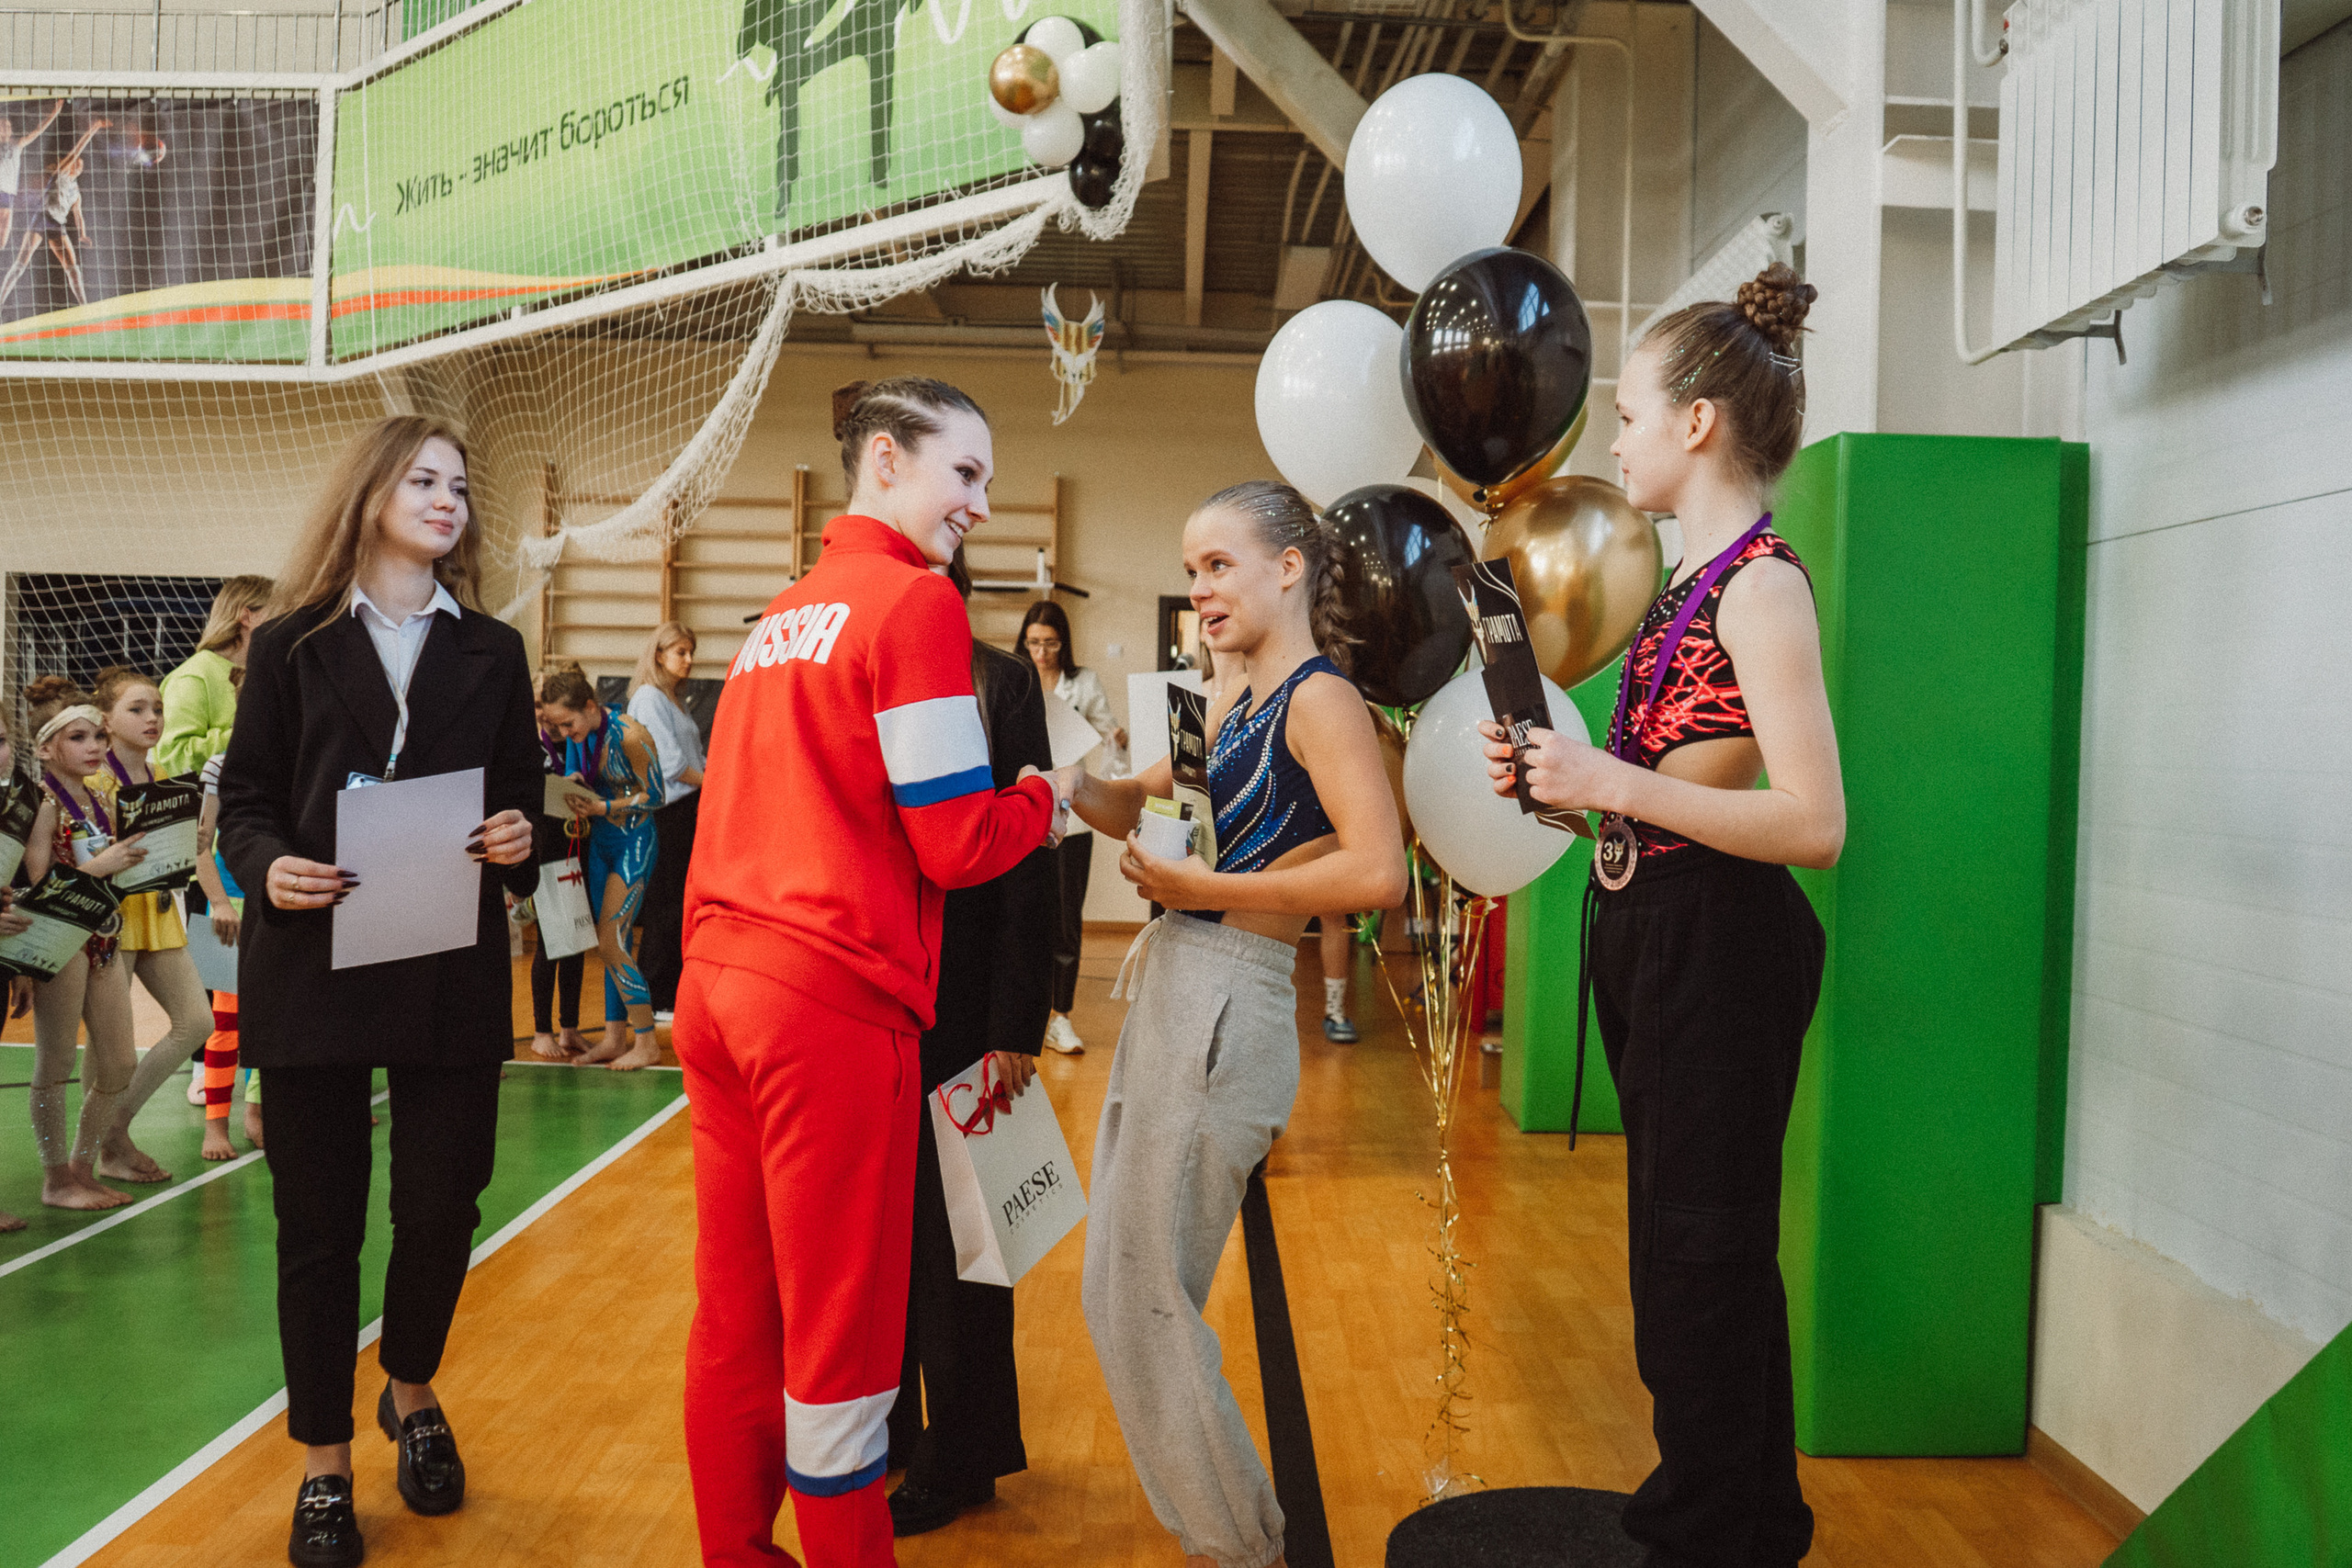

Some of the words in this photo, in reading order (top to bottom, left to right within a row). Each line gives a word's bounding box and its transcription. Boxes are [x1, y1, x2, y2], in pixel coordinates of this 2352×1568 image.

[395, 172, 453, 216] Жить
[473, 127, 553, 184] значит
[560, 74, 689, 149] бороться
[1481, 613, 1523, 644] ГРАМОТА
[144, 793, 190, 816] ГРАМОТА
[1602, 841, 1613, 862] 3
[60, 889, 107, 915] ГРАМОТА
[1001, 1160, 1060, 1227] PAESE
